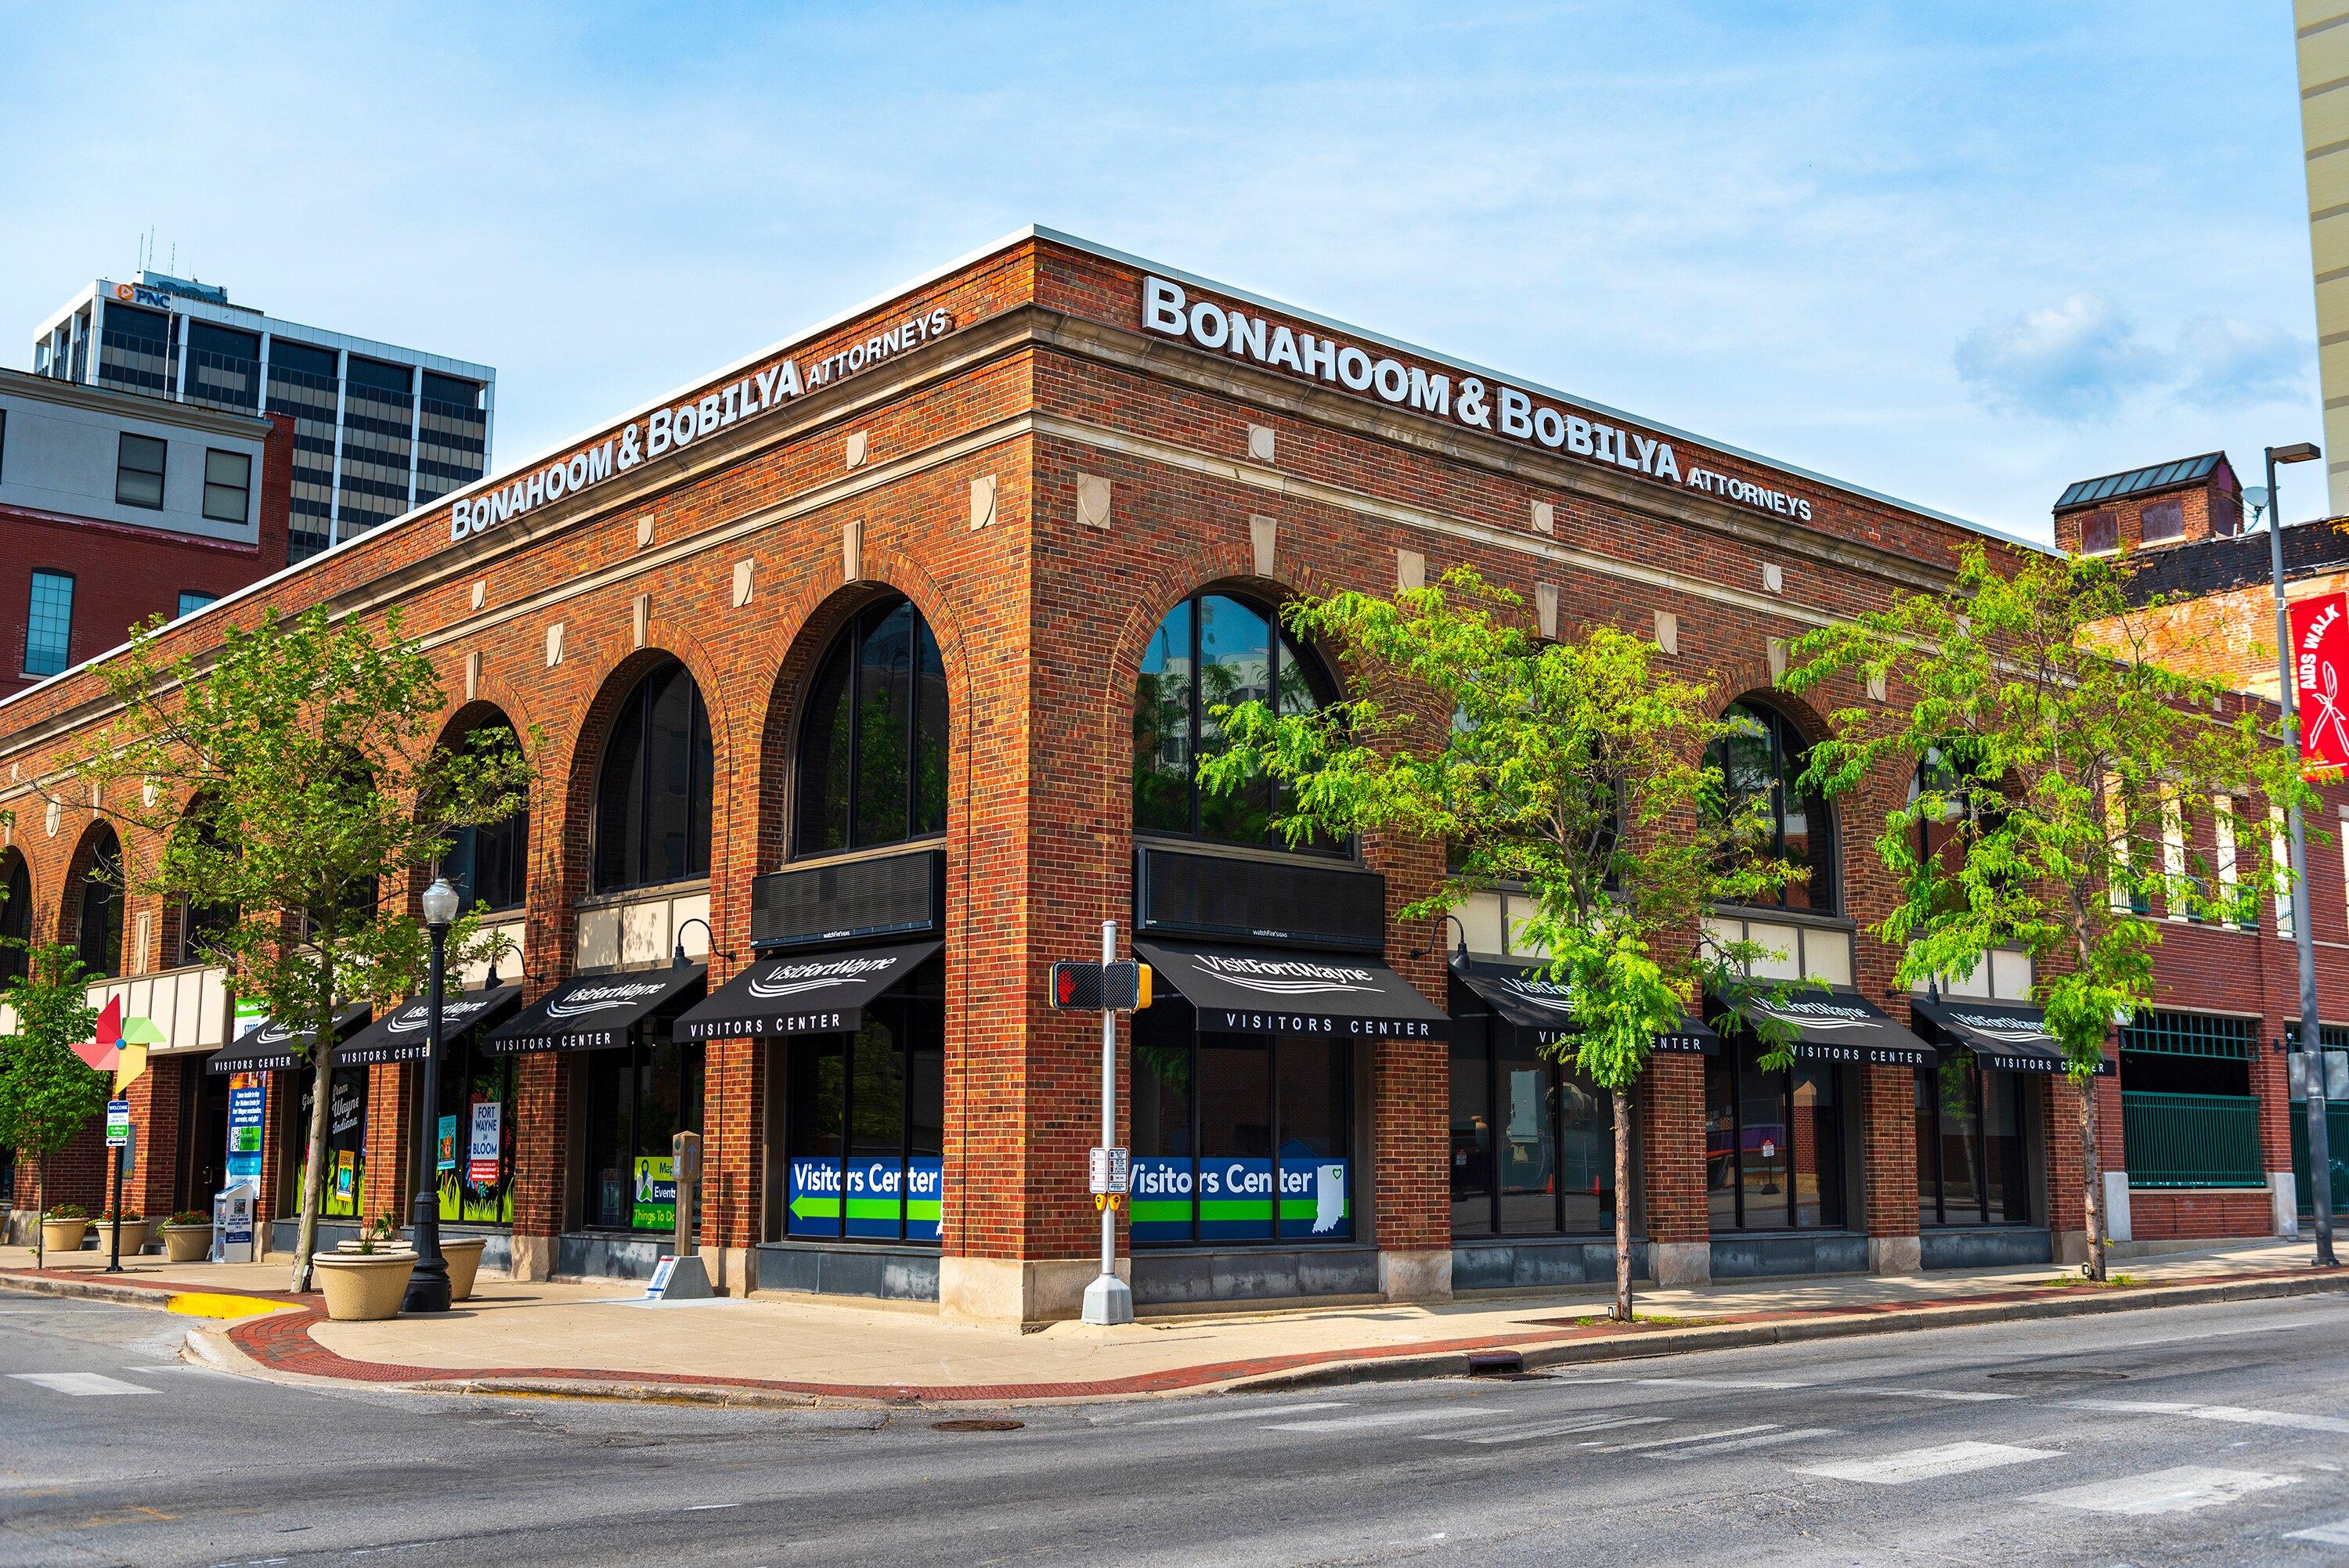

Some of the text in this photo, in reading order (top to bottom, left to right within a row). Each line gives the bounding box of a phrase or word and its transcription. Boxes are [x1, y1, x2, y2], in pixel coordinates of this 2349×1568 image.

[135, 288, 171, 309] PNC
[1142, 276, 1813, 521] BONAHOOM & BOBILYA ATTORNEYS
[451, 307, 951, 542] BONAHOOM & BOBILYA ATTORNEYS
[2300, 603, 2341, 690] AIDS WALK
[691, 1013, 840, 1036] VISITORS CENTER
[1226, 1013, 1430, 1036] VISITORS CENTER
[495, 1032, 611, 1051] VISITORS CENTER
[341, 1050, 388, 1063] VISITORS
[394, 1047, 428, 1061] CENTE
[1791, 1044, 1923, 1064] VISITORS CENTER
[215, 1056, 291, 1072] VISITORS CENTER
[1994, 1057, 2105, 1072] VISITORS CEER
[332, 1096, 359, 1118] Wayne
[478, 1106, 496, 1119] FORT
[332, 1116, 358, 1134] Indiana
[475, 1119, 497, 1131] WAYNE
[472, 1142, 498, 1155] BLOOM
[1226, 1163, 1312, 1194] Center
[634, 1209, 655, 1224] Things
[656, 1209, 665, 1222] To
